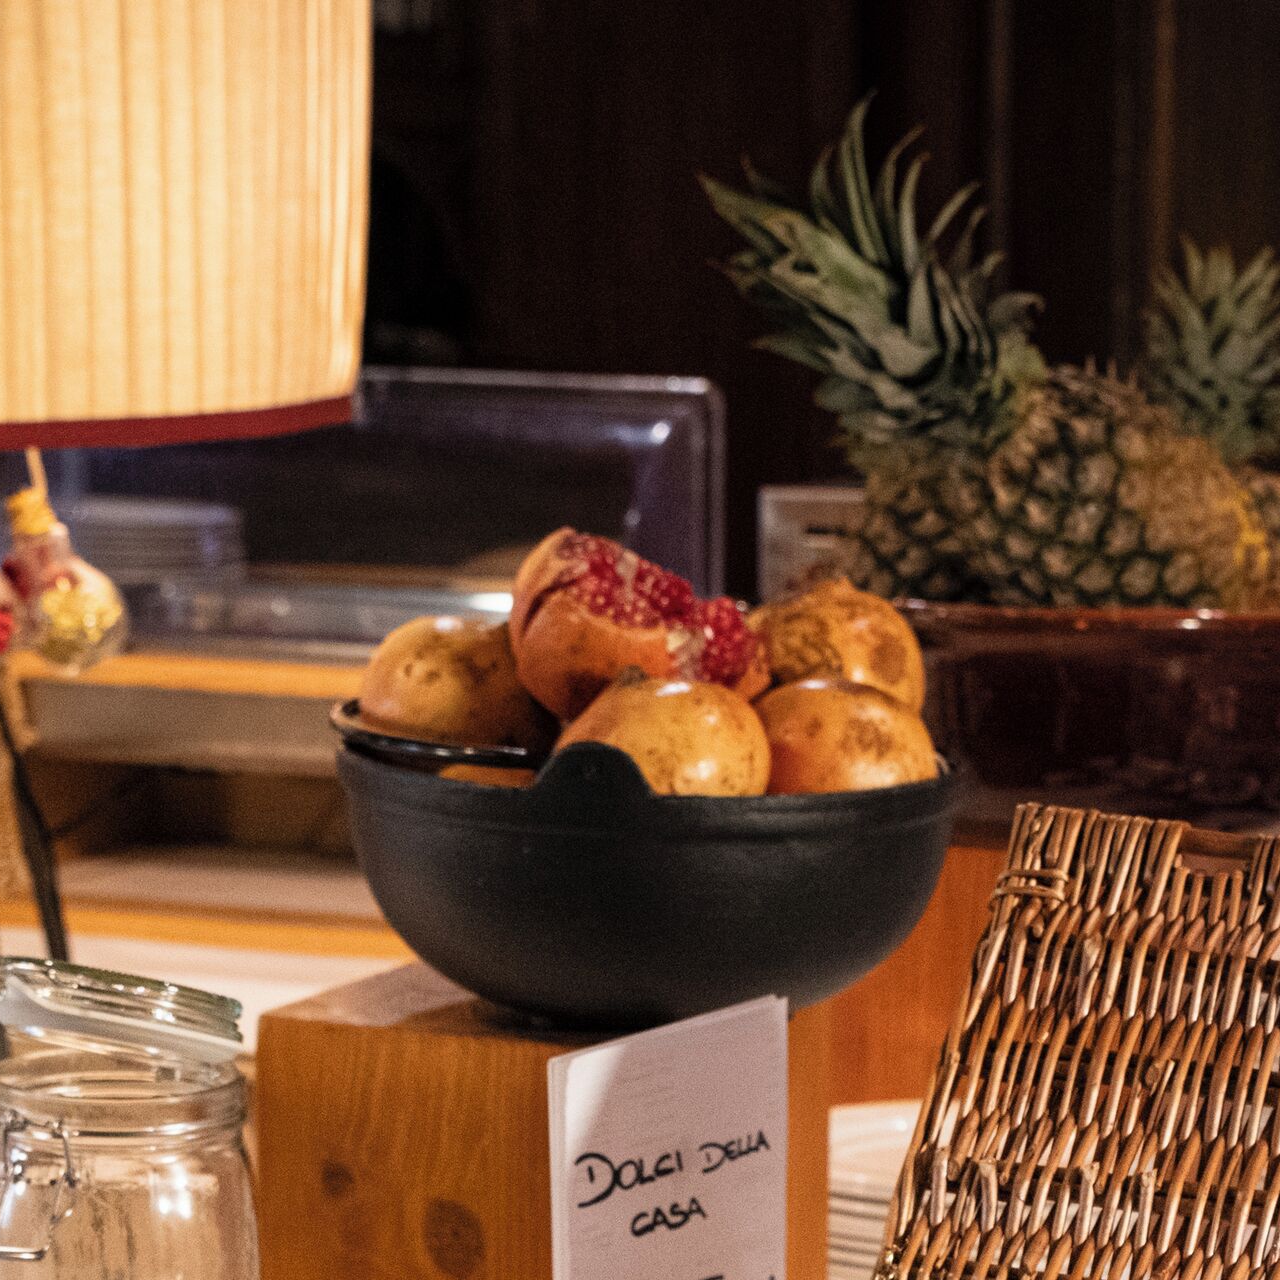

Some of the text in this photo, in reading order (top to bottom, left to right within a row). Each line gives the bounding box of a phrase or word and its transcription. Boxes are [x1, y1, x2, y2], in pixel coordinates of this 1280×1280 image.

[575, 1129, 771, 1209] DOLCI DELLA
[630, 1197, 708, 1238] CASA
